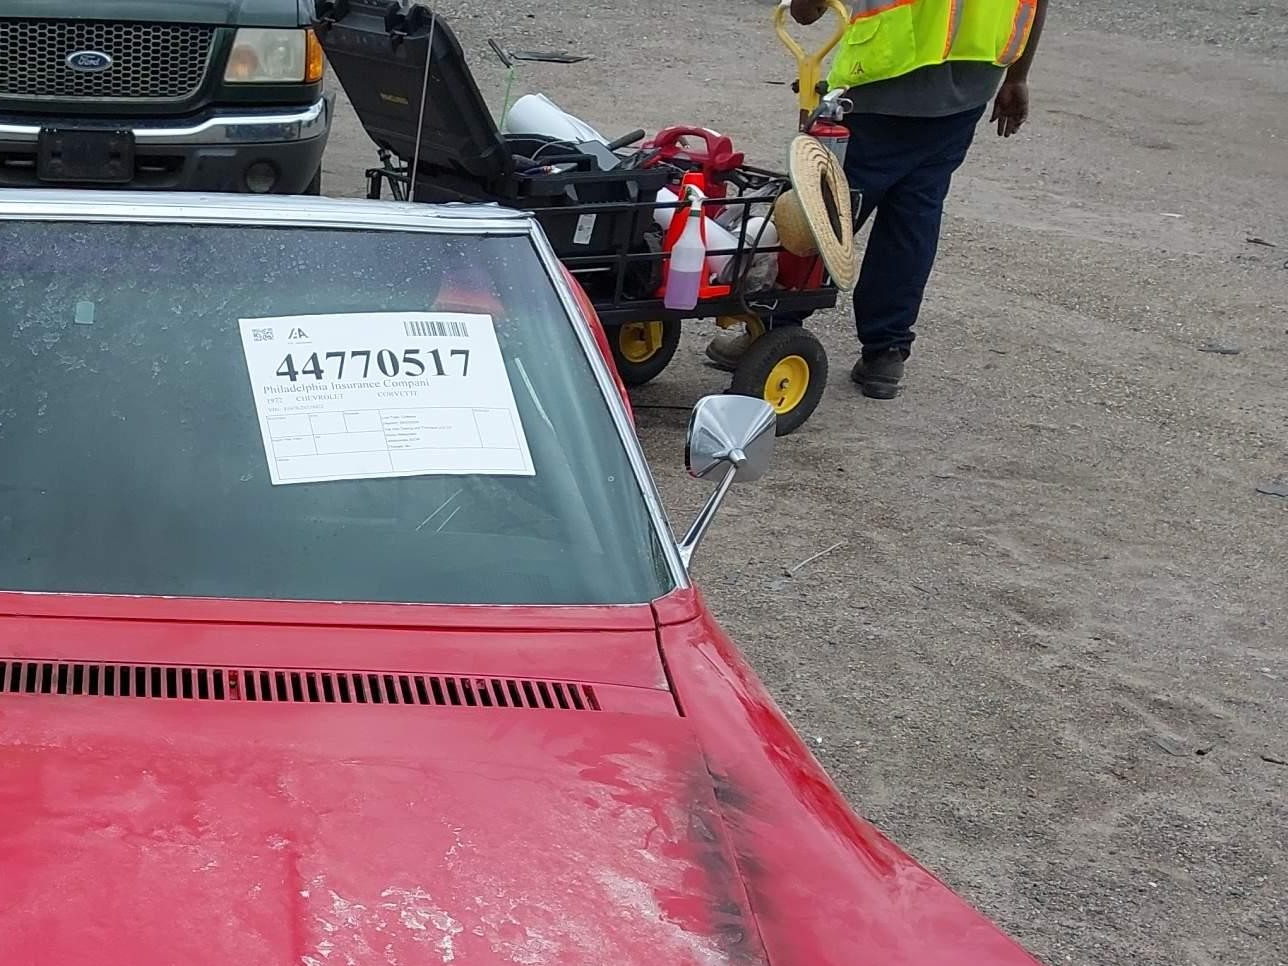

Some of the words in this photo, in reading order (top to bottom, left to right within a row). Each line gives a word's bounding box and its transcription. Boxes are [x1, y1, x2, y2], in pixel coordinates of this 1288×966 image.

[275, 348, 471, 382] 44770517
[263, 382, 328, 394] Philadelphia
[331, 381, 380, 391] Insurance
[296, 393, 345, 402] CHEVROLET
